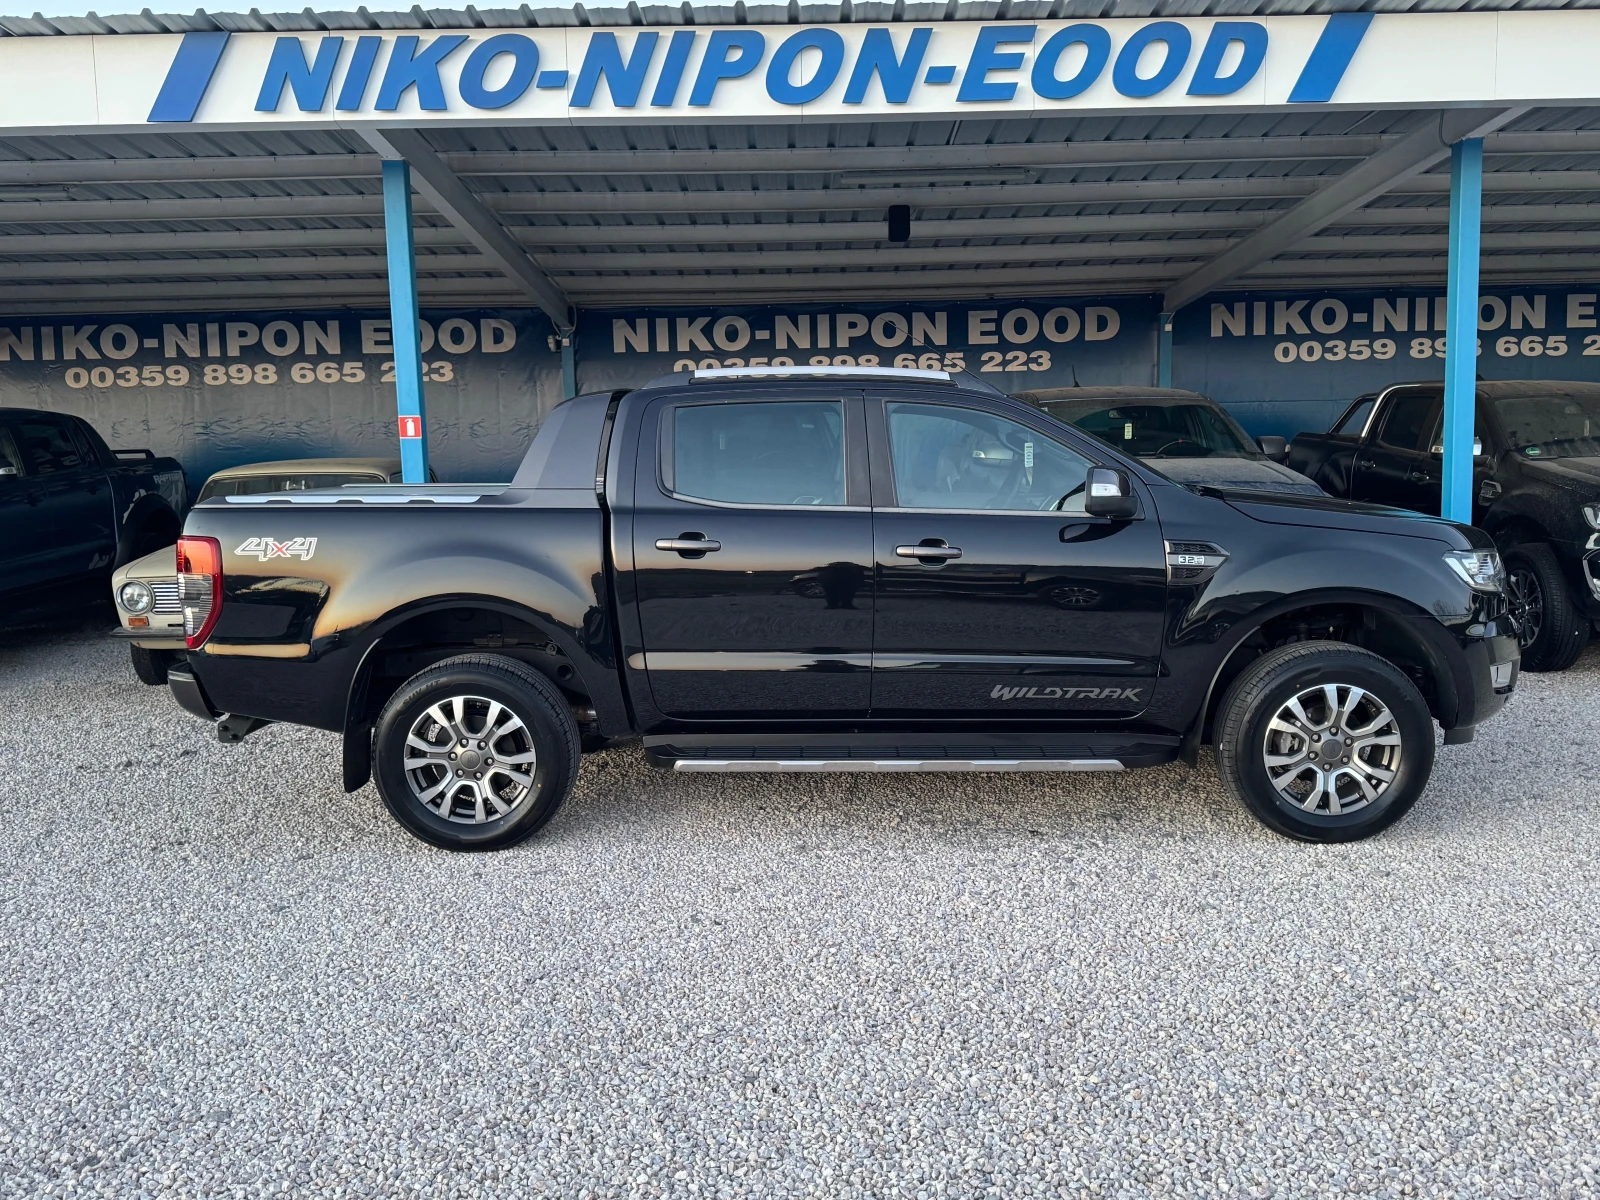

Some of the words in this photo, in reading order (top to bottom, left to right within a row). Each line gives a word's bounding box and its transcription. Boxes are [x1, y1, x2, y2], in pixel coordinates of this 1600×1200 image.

[254, 21, 1268, 112] NIKO-NIPON-EOOD
[0, 319, 341, 361] NIKO-NIPON
[612, 311, 948, 353] NIKO-NIPON
[967, 306, 1121, 346] EOOD
[893, 352, 965, 373] 665
[980, 350, 1052, 372] 223
[1274, 338, 1397, 363] 00359
[1495, 335, 1569, 357] 665
[65, 364, 190, 388] 00359
[203, 362, 277, 386] 898
[290, 361, 366, 384] 665
[990, 684, 1143, 702] WILDTRAK
